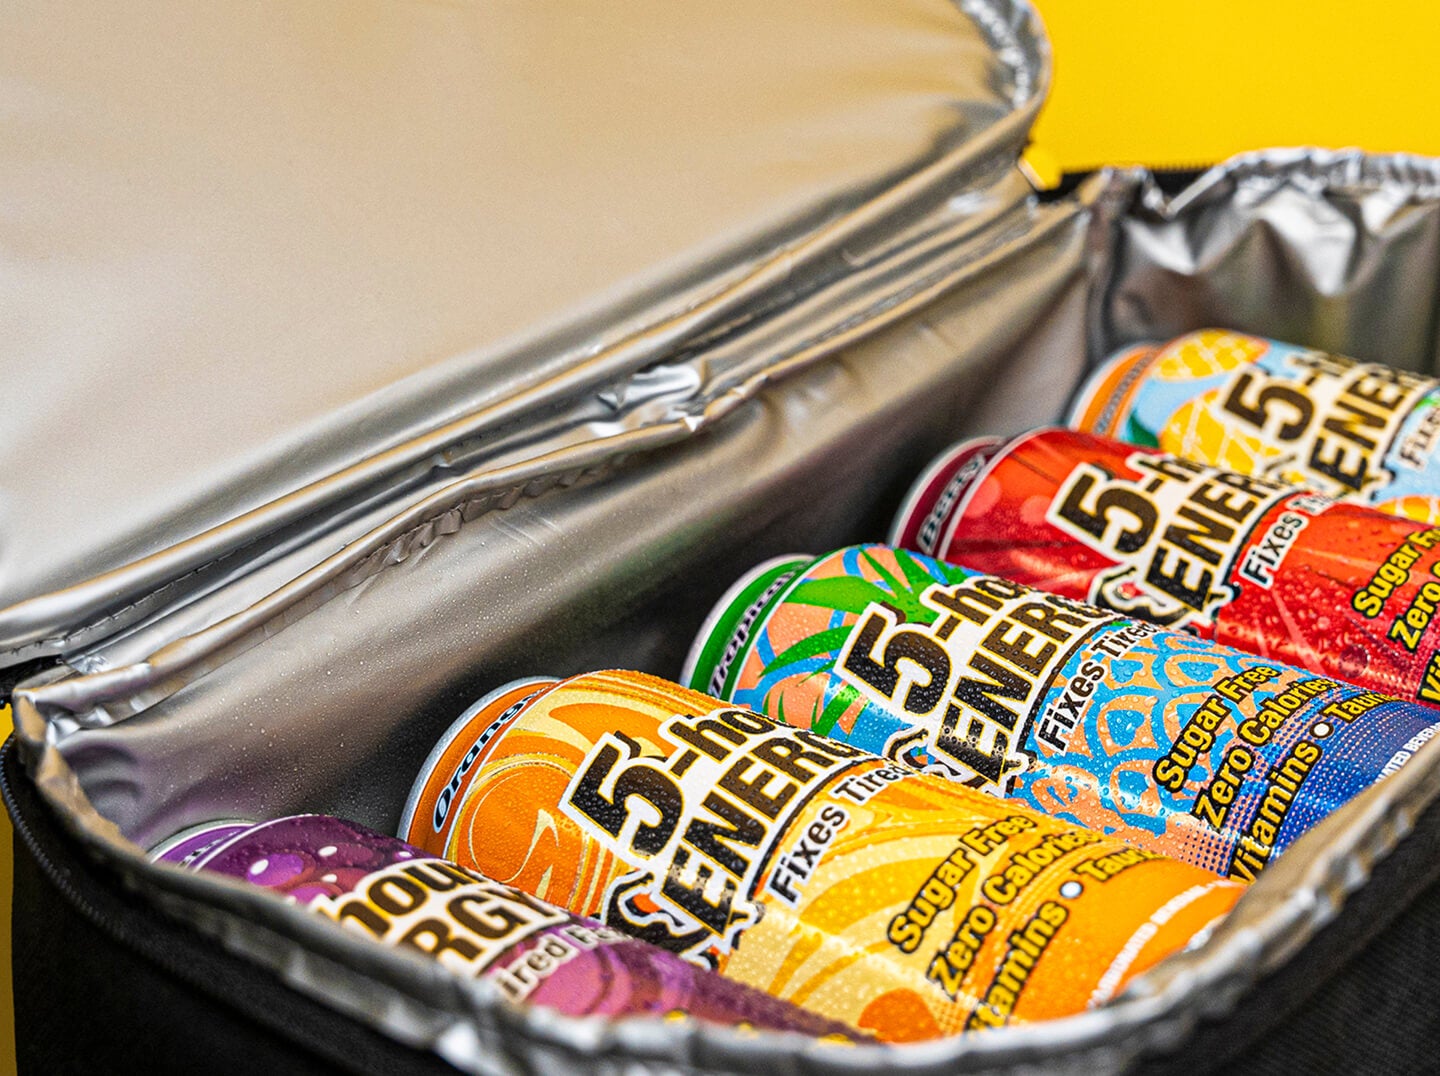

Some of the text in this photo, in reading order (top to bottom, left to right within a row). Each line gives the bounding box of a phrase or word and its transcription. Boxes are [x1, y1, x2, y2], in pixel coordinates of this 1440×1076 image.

[1242, 514, 1304, 586] Fixes
[1353, 543, 1420, 617] Sugar
[708, 571, 796, 698] Tropical
[1038, 619, 1164, 752] Fixes Tired
[1155, 666, 1279, 789] Sugar Free
[1196, 678, 1340, 828] Zero Calories
[771, 762, 911, 903] Fixes Tired
[1229, 741, 1319, 885] Vitamins
[890, 816, 1036, 951] Sugar Free
[930, 831, 1102, 997] Zero Calories
[498, 941, 568, 996] ired
[970, 902, 1067, 1030] tamins
